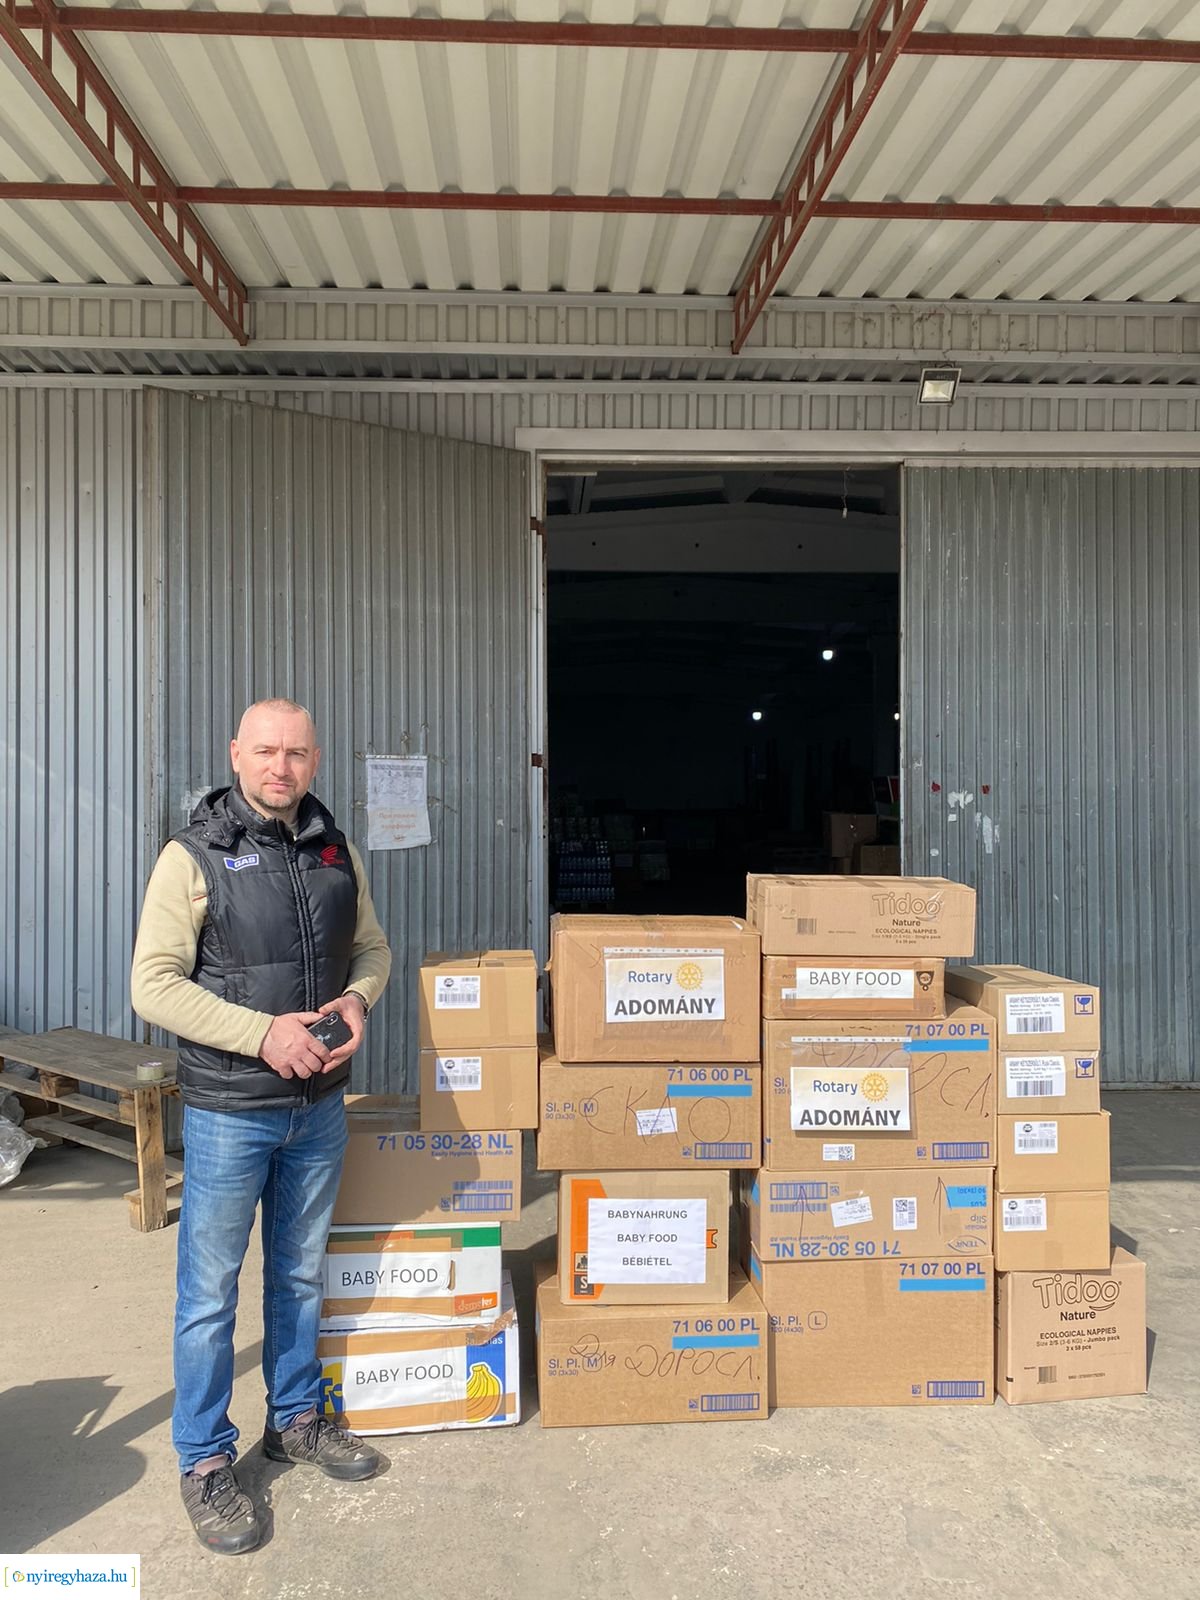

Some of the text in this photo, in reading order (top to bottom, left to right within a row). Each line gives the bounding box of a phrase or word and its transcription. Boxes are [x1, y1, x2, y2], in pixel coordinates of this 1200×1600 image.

[233, 857, 257, 869] GAS
[872, 891, 941, 916] Tidoo
[892, 919, 921, 927] Nature
[628, 971, 672, 985] Rotary
[809, 971, 851, 985] BABY
[856, 971, 902, 986] FOOD
[614, 995, 716, 1016] ADOMÁNY
[905, 1023, 989, 1036] 71 07 00 PL
[667, 1068, 753, 1082] 71 06 00 PL
[813, 1080, 858, 1095] Rotary
[583, 1102, 594, 1113] M
[800, 1107, 901, 1126] ADOMÁNY
[377, 1133, 513, 1150] 71 05 30-28 NL
[608, 1210, 688, 1219] BABYNAHRUNG
[970, 1214, 987, 1224] Slip
[617, 1233, 678, 1243] BABY FOOD
[956, 1240, 978, 1248] TENA
[770, 1240, 901, 1257] 71 05 30-28 NL
[622, 1255, 672, 1266] BÉBIÉTEL
[899, 1263, 986, 1276] 71 07 00 PL
[341, 1268, 438, 1287] BABY FOOD
[1032, 1272, 1120, 1309] Tidoo
[814, 1315, 821, 1325] L
[1060, 1311, 1096, 1321] Nature
[673, 1318, 760, 1333] 71 06 00 PL
[1040, 1327, 1117, 1340] ECOLOGICAL NAPPIES
[587, 1357, 598, 1368] M
[355, 1364, 453, 1385] BABY FOOD
